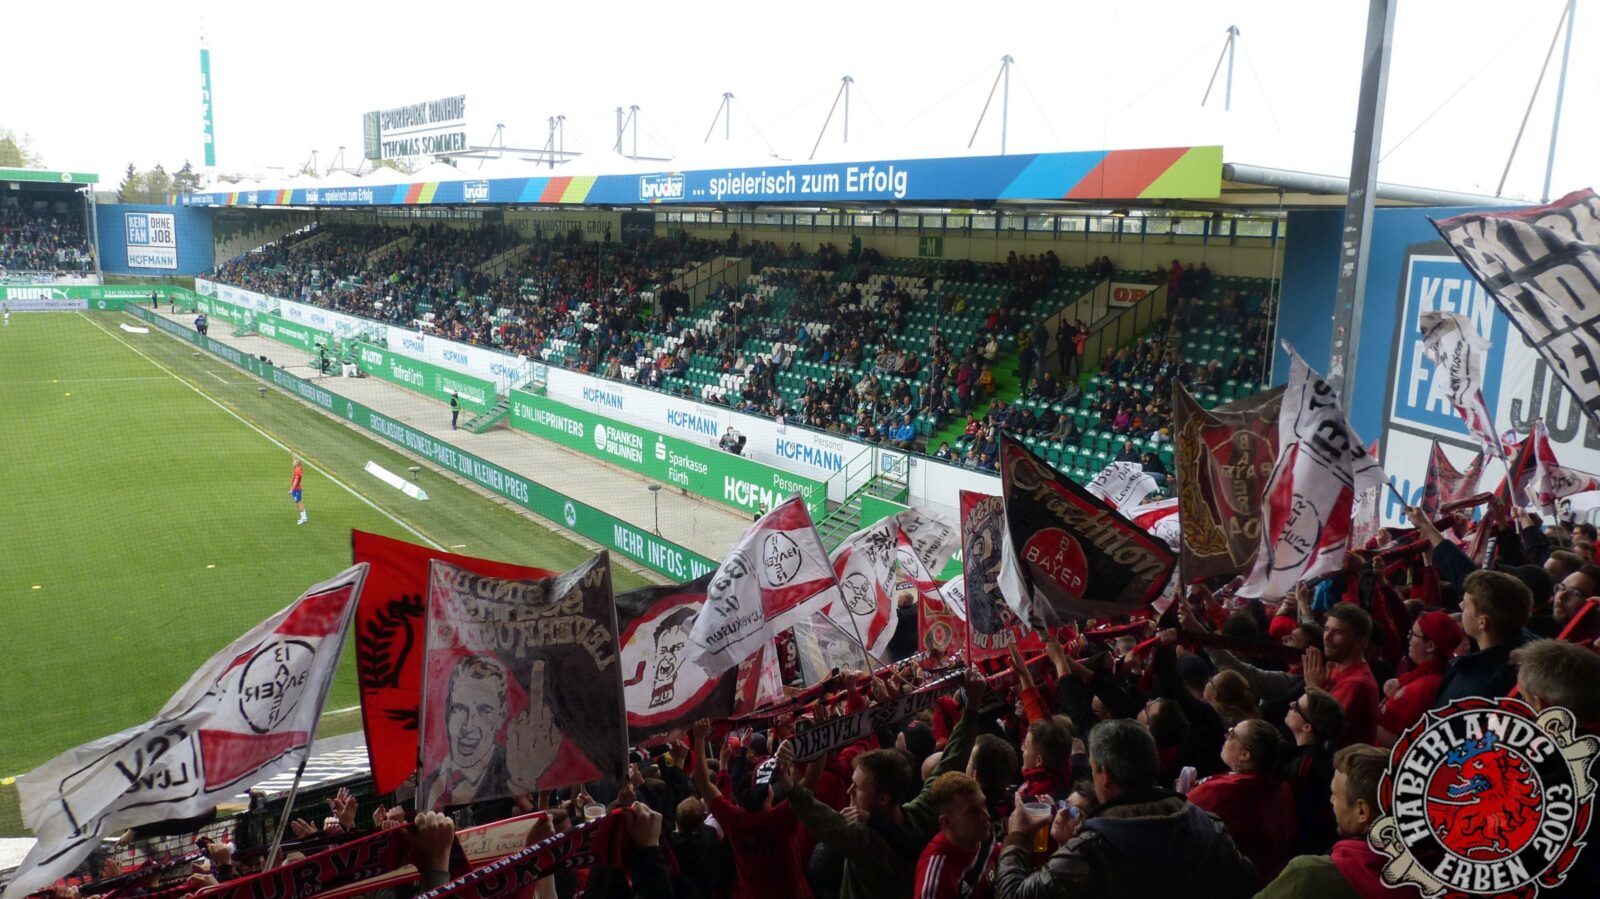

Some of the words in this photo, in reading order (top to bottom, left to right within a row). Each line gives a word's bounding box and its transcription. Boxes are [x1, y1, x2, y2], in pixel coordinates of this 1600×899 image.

[383, 138, 420, 158] THOMAS
[422, 132, 467, 154] SOMMER
[641, 178, 683, 198] bruder
[709, 170, 796, 200] spielerisch
[801, 174, 838, 193] zum
[846, 166, 908, 198] Erfolg
[128, 216, 146, 228] KEIN
[151, 217, 171, 229] OHNE
[130, 228, 147, 242] FAN
[151, 230, 174, 244] JOB.
[129, 255, 173, 266] HOFMANN
[1417, 277, 1497, 347] KEIN
[443, 349, 469, 365] HOFMANN
[583, 387, 623, 410] HOFMANN
[521, 404, 584, 438] ONLINEPRINTERS
[667, 409, 718, 437] HOFMANN
[606, 426, 643, 449] FRANKEN
[606, 441, 643, 464] BRUNNEN
[668, 451, 708, 476] Sparkasse
[776, 438, 843, 472] HOFMANN
[406, 427, 458, 469] BUSINESS-PAKETE
[458, 453, 473, 478] ZUM
[473, 460, 503, 490] KLEINEN
[505, 472, 529, 503] PREIS
[668, 468, 689, 486] Fürth
[614, 524, 644, 559] MEHR
[647, 540, 687, 580] INFOS:
